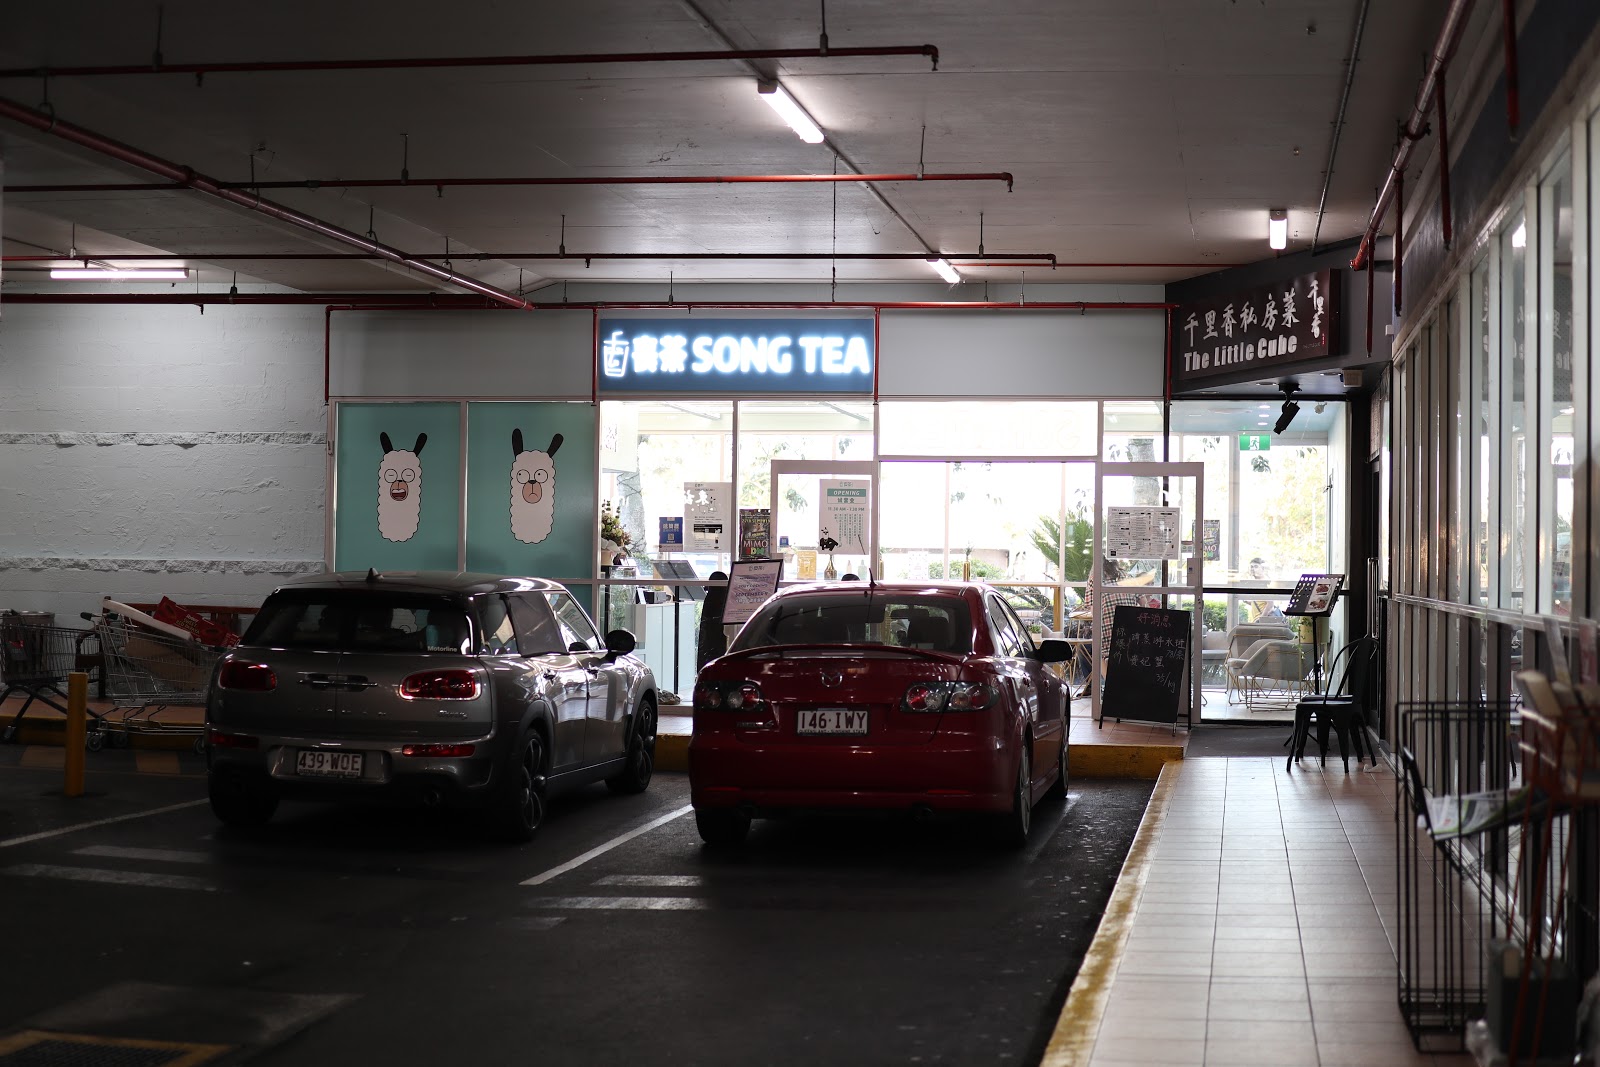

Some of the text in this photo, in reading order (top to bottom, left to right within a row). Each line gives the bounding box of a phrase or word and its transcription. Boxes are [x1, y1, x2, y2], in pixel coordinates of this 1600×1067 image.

[1184, 287, 1300, 347] 千里香私房菜
[692, 336, 792, 373] SONG
[799, 336, 870, 373] TEA
[1184, 351, 1210, 372] The
[1214, 342, 1255, 367] Little
[1257, 334, 1298, 359] Cube
[1137, 612, 1171, 627] 好消息
